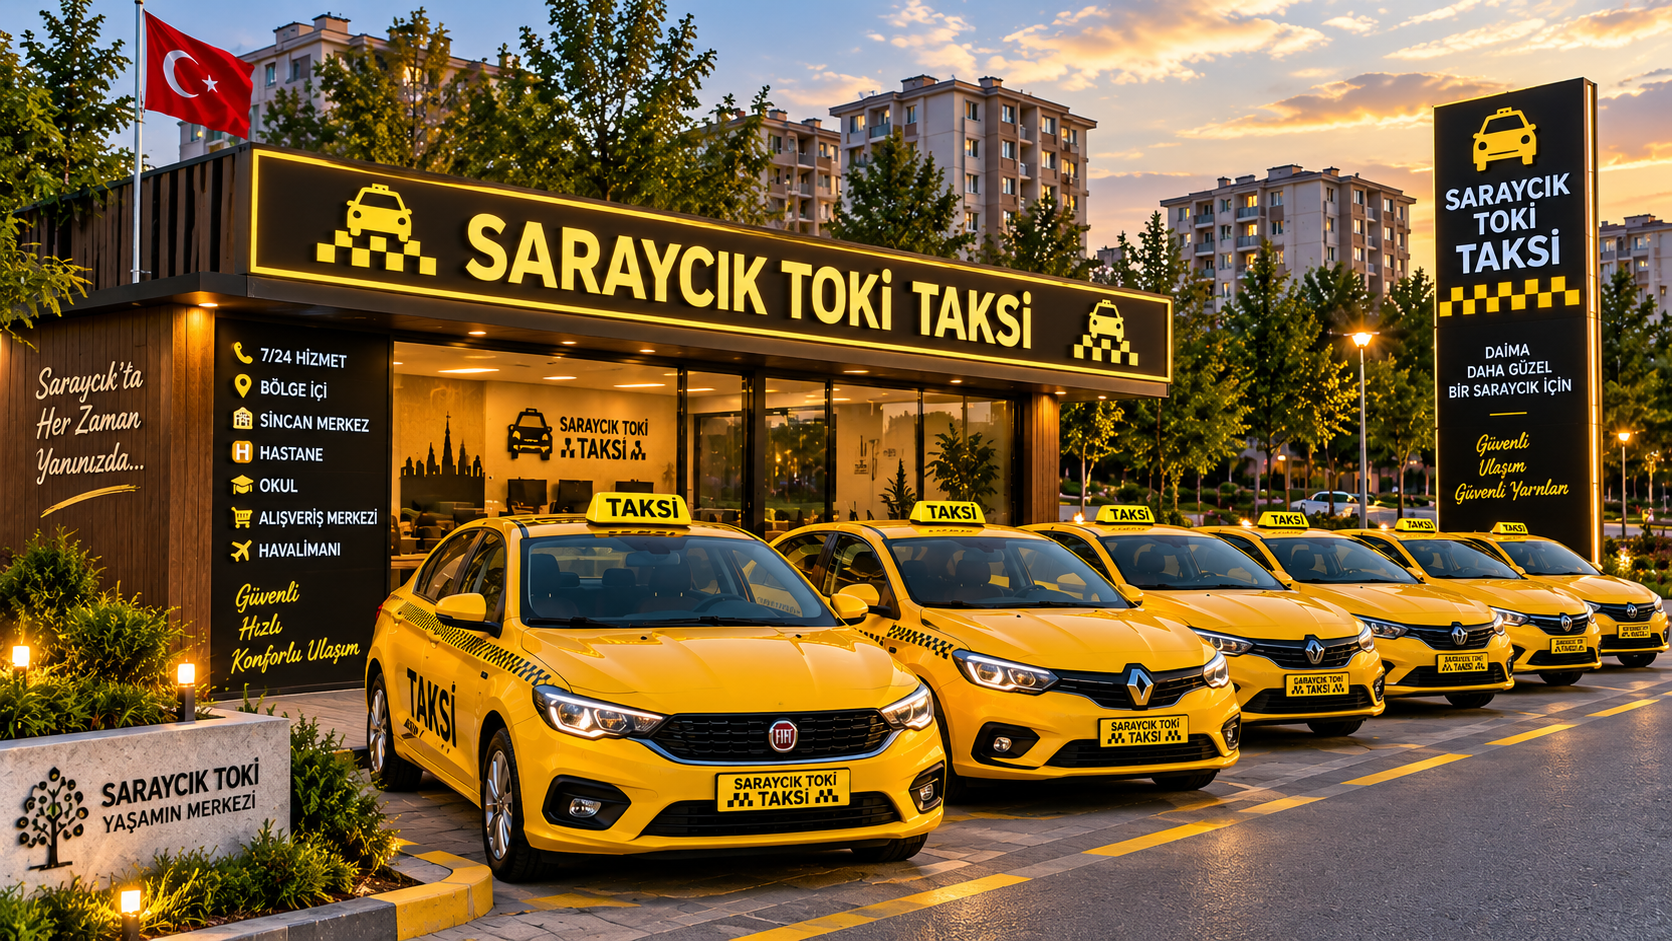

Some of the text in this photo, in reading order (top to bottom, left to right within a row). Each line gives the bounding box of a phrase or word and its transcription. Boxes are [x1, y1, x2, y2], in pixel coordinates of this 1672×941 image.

[1445, 172, 1571, 211] SARAYCIK
[465, 213, 768, 315] SARAYCIK
[260, 347, 348, 369] 7/24 HİZMET
[1485, 342, 1530, 359] DAİMA
[1467, 359, 1552, 379] DAHA GÜZEL
[260, 377, 328, 402] BÖLGE İÇİ
[1448, 376, 1572, 399] BİR SARAYCIK İÇİN
[36, 404, 142, 440] Her Zaman
[260, 410, 370, 433] SİNCAN MERKEZ
[560, 416, 619, 435] SARAYCIK
[260, 445, 324, 462] HASTANE
[1476, 431, 1530, 457] Güvenli
[1479, 457, 1527, 479] Ulaşım
[259, 478, 298, 493] OKUL
[1454, 480, 1506, 505] Güvenli
[258, 508, 378, 528] ALIŞVERİŞ MERKEZİ
[606, 497, 679, 519] TAKSİ
[926, 502, 977, 520] TAKSİ
[258, 539, 341, 558] HAVALİMANI
[235, 580, 300, 613] Güvenli
[238, 613, 283, 641] Hızlı
[231, 637, 360, 675] Konforlu Ulaşım
[1111, 720, 1157, 732] SARAYCIK
[101, 757, 259, 808] SARAYCIK TOKİ
[734, 775, 802, 790] SARAYCIK
[103, 790, 256, 834] YAŞAMIN MERKEZİ
